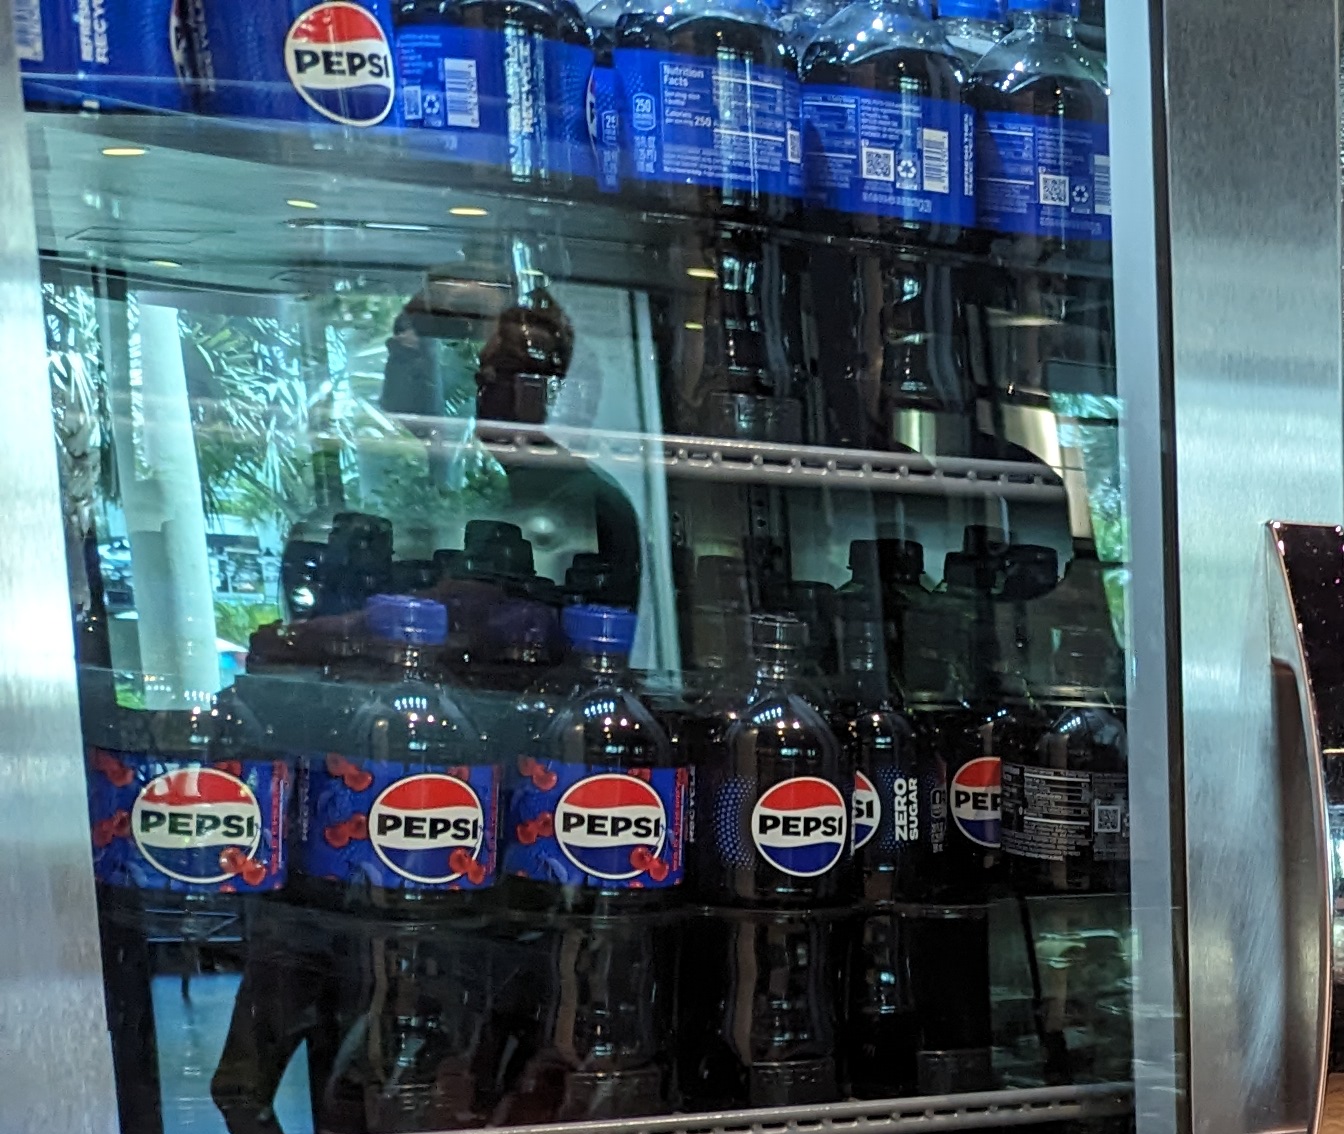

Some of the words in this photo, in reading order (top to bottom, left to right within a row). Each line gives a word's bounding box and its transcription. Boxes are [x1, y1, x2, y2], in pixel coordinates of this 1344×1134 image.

[294, 48, 390, 79] PEPSI
[894, 777, 908, 842] ZERO
[909, 777, 920, 842] SUGAR
[954, 790, 1001, 812] PEP
[140, 809, 256, 839] PEPSI
[376, 813, 479, 841] PEPSI
[561, 811, 662, 839] PEPSI
[758, 814, 844, 838] PEPSI
